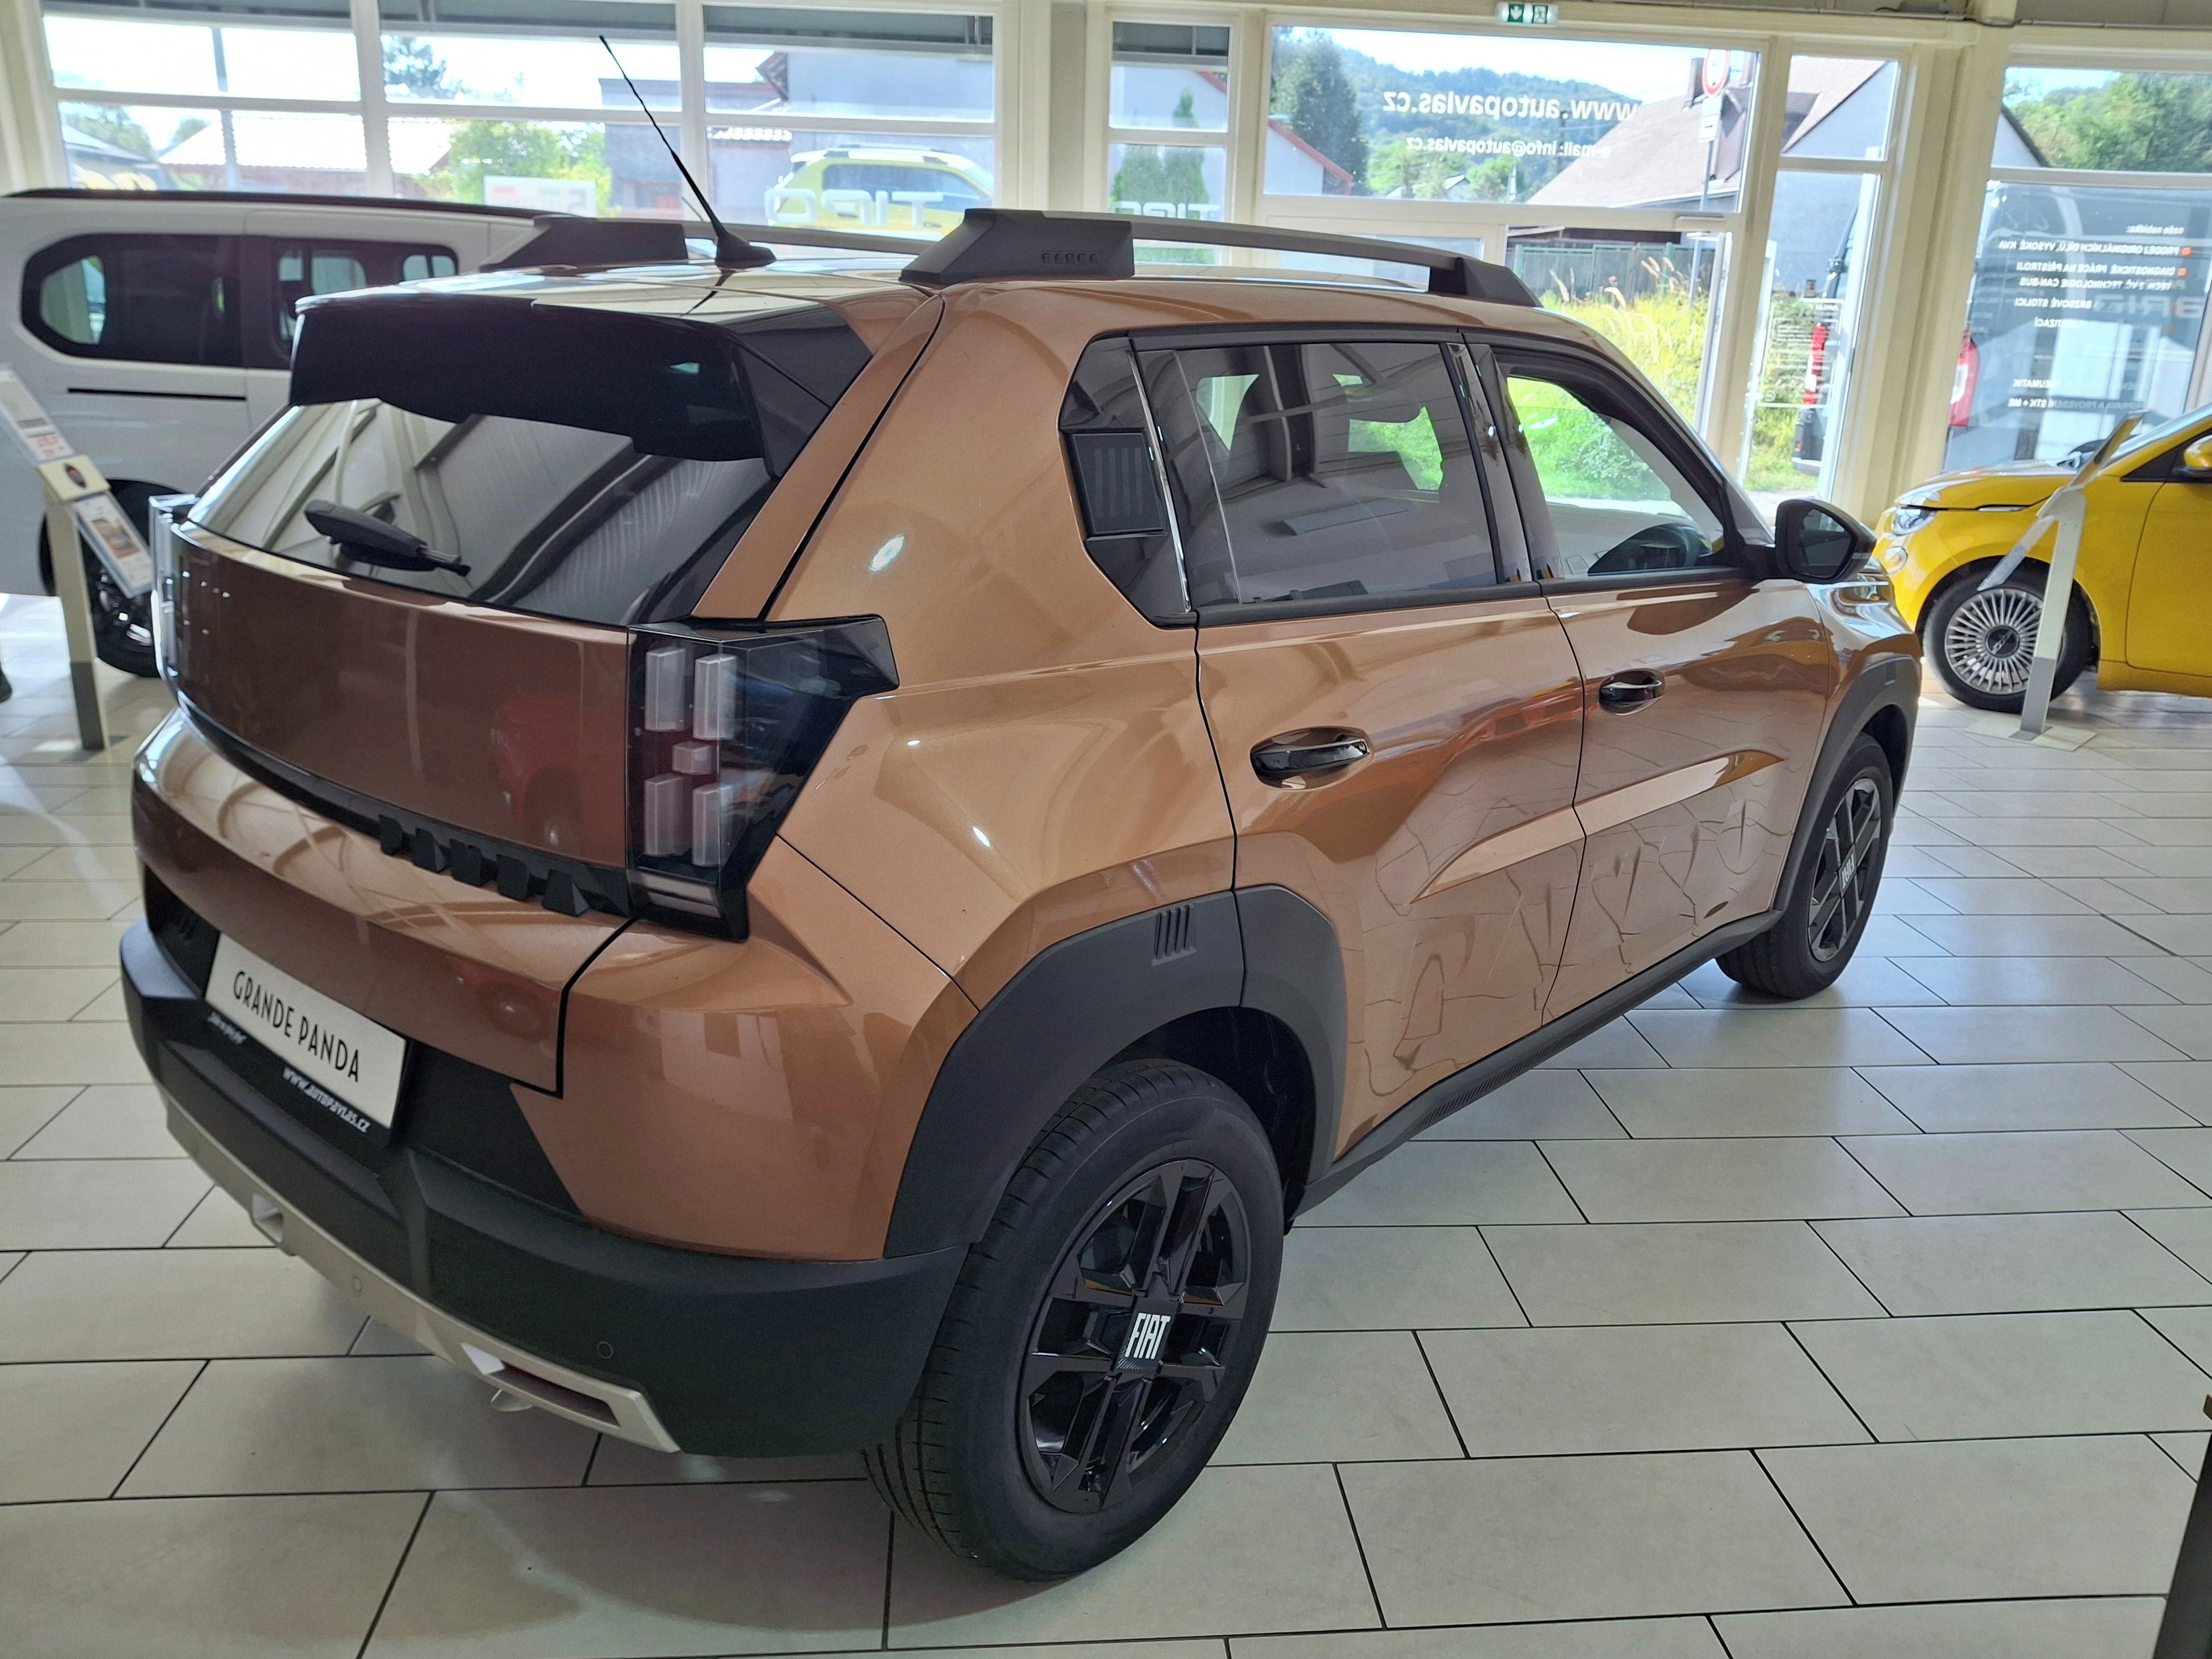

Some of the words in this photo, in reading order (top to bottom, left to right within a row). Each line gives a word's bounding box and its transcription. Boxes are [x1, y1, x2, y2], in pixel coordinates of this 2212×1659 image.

[1842, 853, 1855, 890] FIAT
[233, 970, 294, 1038] GRANDE
[298, 1015, 359, 1083] PANDA
[1124, 1312, 1172, 1360] FIAT
